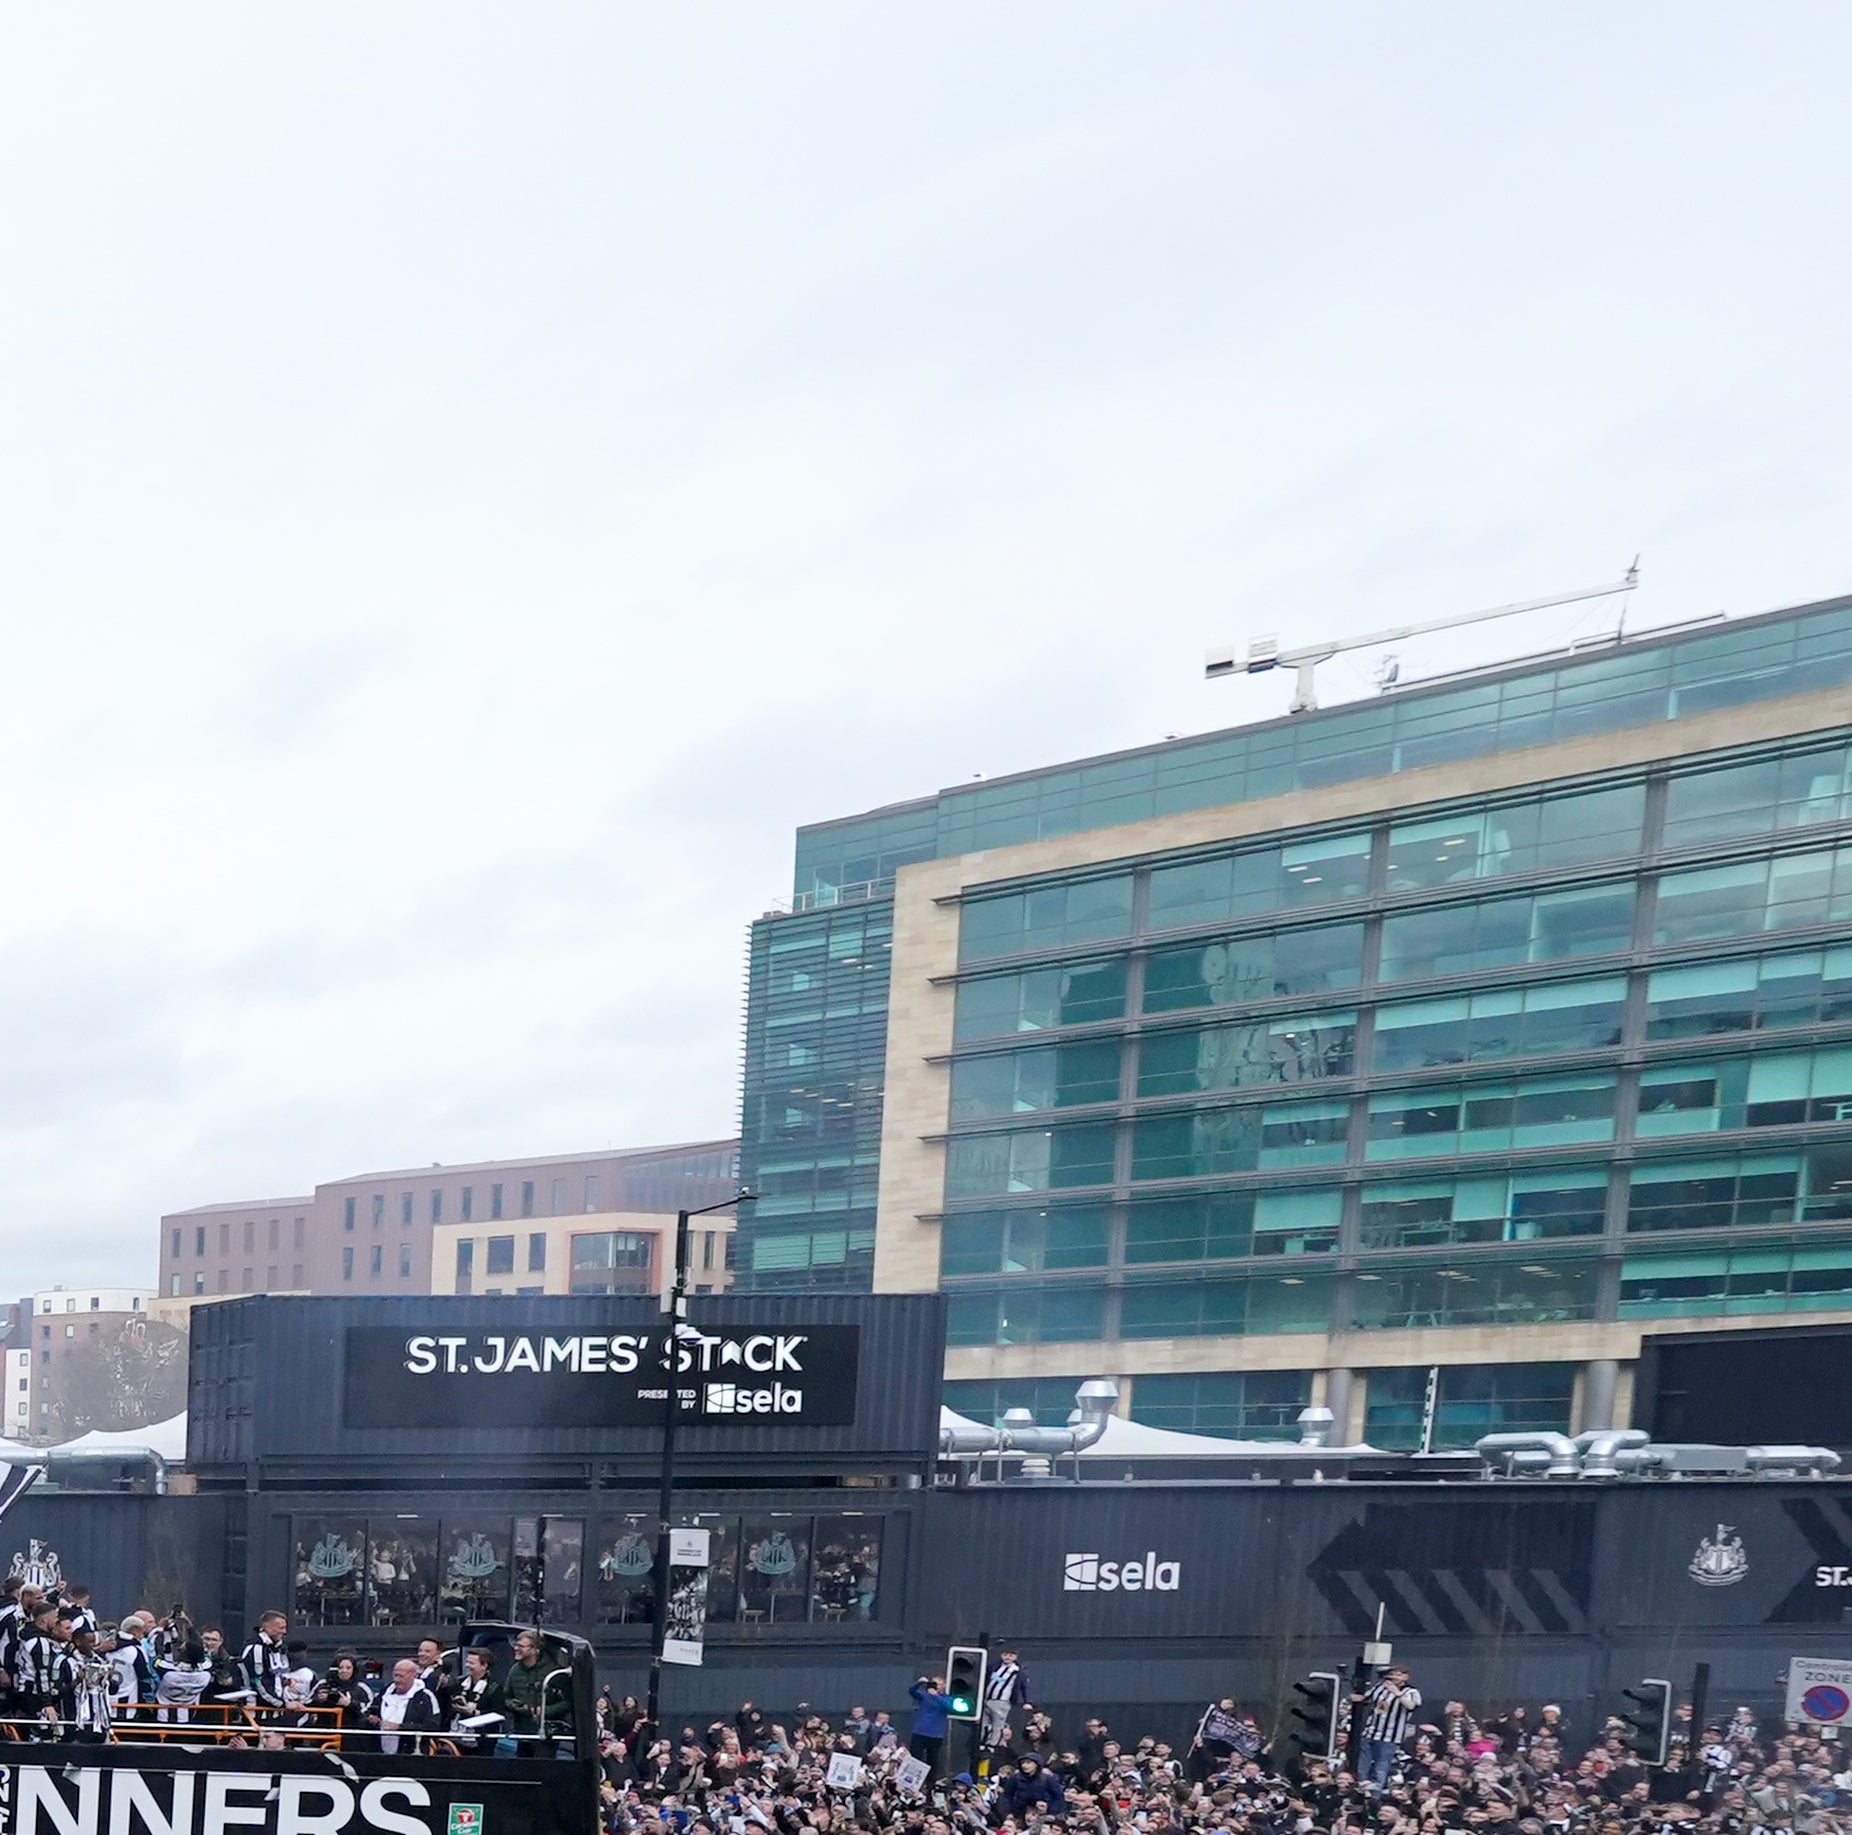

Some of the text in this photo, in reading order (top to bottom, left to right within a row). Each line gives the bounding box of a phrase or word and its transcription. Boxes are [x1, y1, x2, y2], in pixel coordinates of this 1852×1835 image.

[637, 1381, 803, 1414] PRESETED sela
[681, 1401, 695, 1410] BY
[1097, 1551, 1181, 1591] sela
[1805, 1671, 1852, 1684] ZONE
